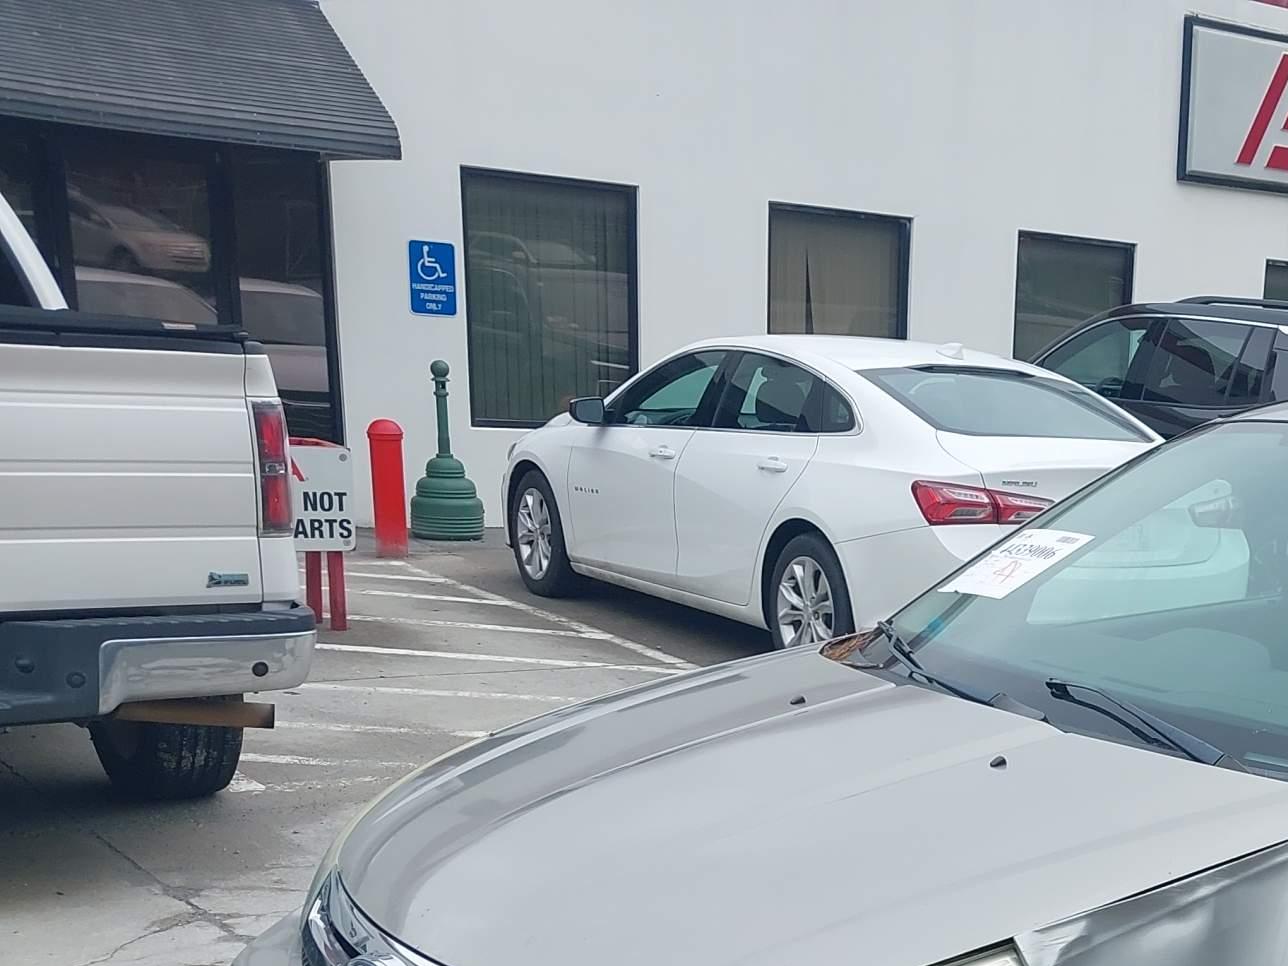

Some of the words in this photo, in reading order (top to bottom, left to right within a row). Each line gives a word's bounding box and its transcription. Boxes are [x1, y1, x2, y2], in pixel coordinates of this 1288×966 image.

[420, 293, 447, 301] PARKING
[425, 302, 442, 310] ONLY
[302, 491, 347, 512] NOT
[293, 518, 352, 539] ARTS
